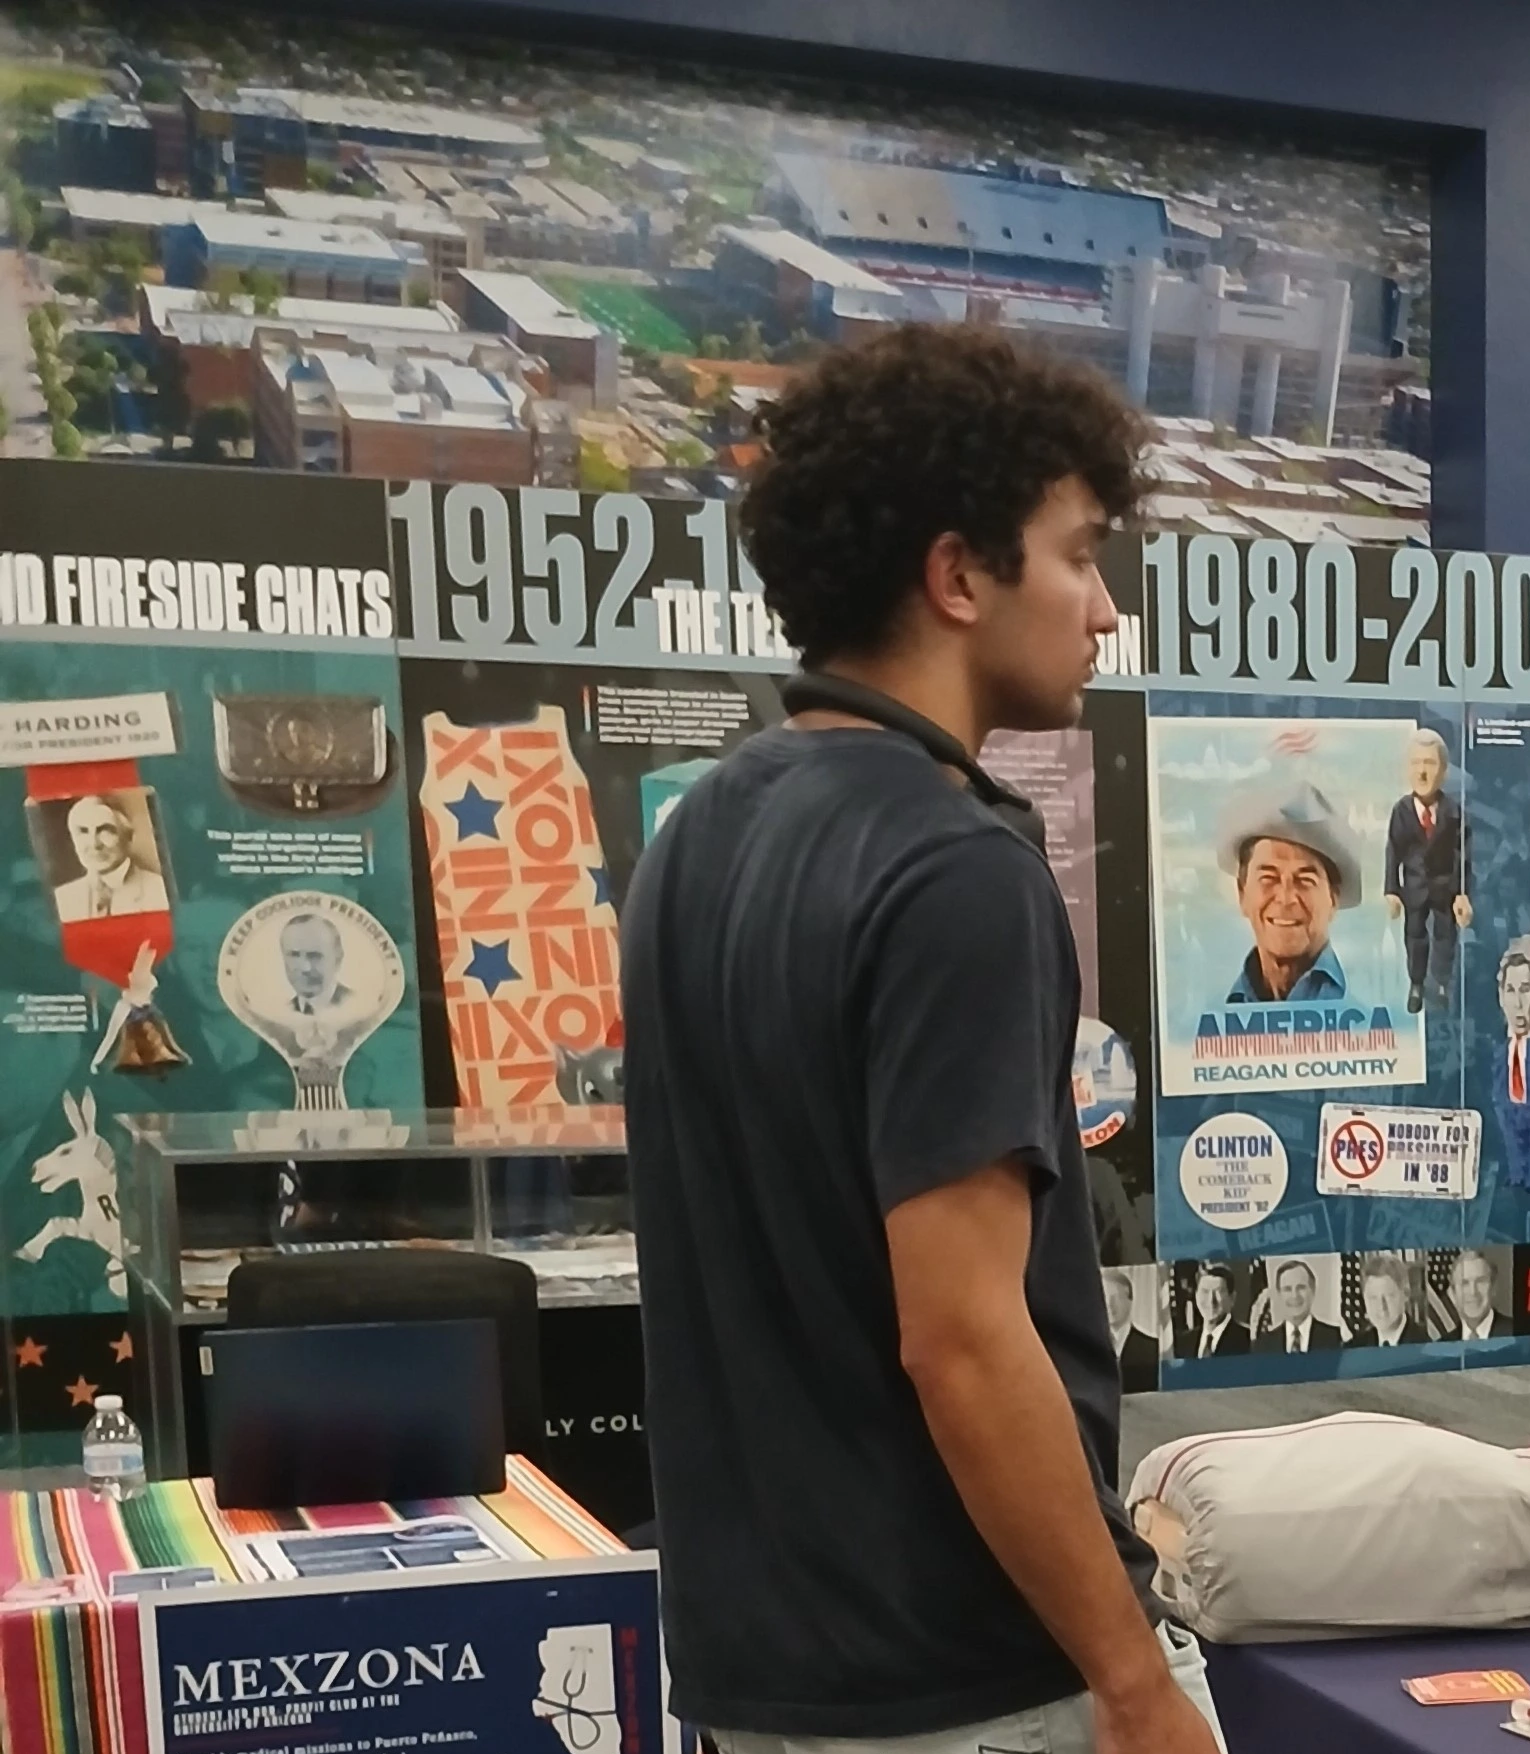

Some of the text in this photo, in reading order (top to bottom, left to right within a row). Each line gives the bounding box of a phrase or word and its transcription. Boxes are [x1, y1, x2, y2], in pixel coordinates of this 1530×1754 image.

[388, 478, 766, 652] 1952-1
[53, 555, 248, 632] FIRESIDE
[254, 565, 392, 638] CHATS
[652, 586, 723, 655] THE
[15, 710, 141, 733] HARDING
[38, 734, 122, 749] PRESIDENT
[329, 899, 397, 960] PRESIDENT
[1193, 1007, 1398, 1059] AMERICA
[1194, 1058, 1398, 1082] REAGAN COUNTRY
[1387, 1123, 1470, 1142] NOBODY FOR
[1195, 1135, 1273, 1159] CLINTON
[1335, 1139, 1379, 1161] PRES
[1387, 1141, 1469, 1162] PRESIDENT
[1199, 1174, 1273, 1186] COMEBACK
[1404, 1163, 1449, 1183] IN '88
[545, 1413, 644, 1437] LY COL
[173, 1642, 486, 1707] MEXZONA
[329, 1697, 358, 1712] CLUB
[362, 1696, 375, 1709] AT
[380, 1693, 400, 1707] THE
[357, 1738, 370, 1750] to
[375, 1734, 418, 1749] Puerto
